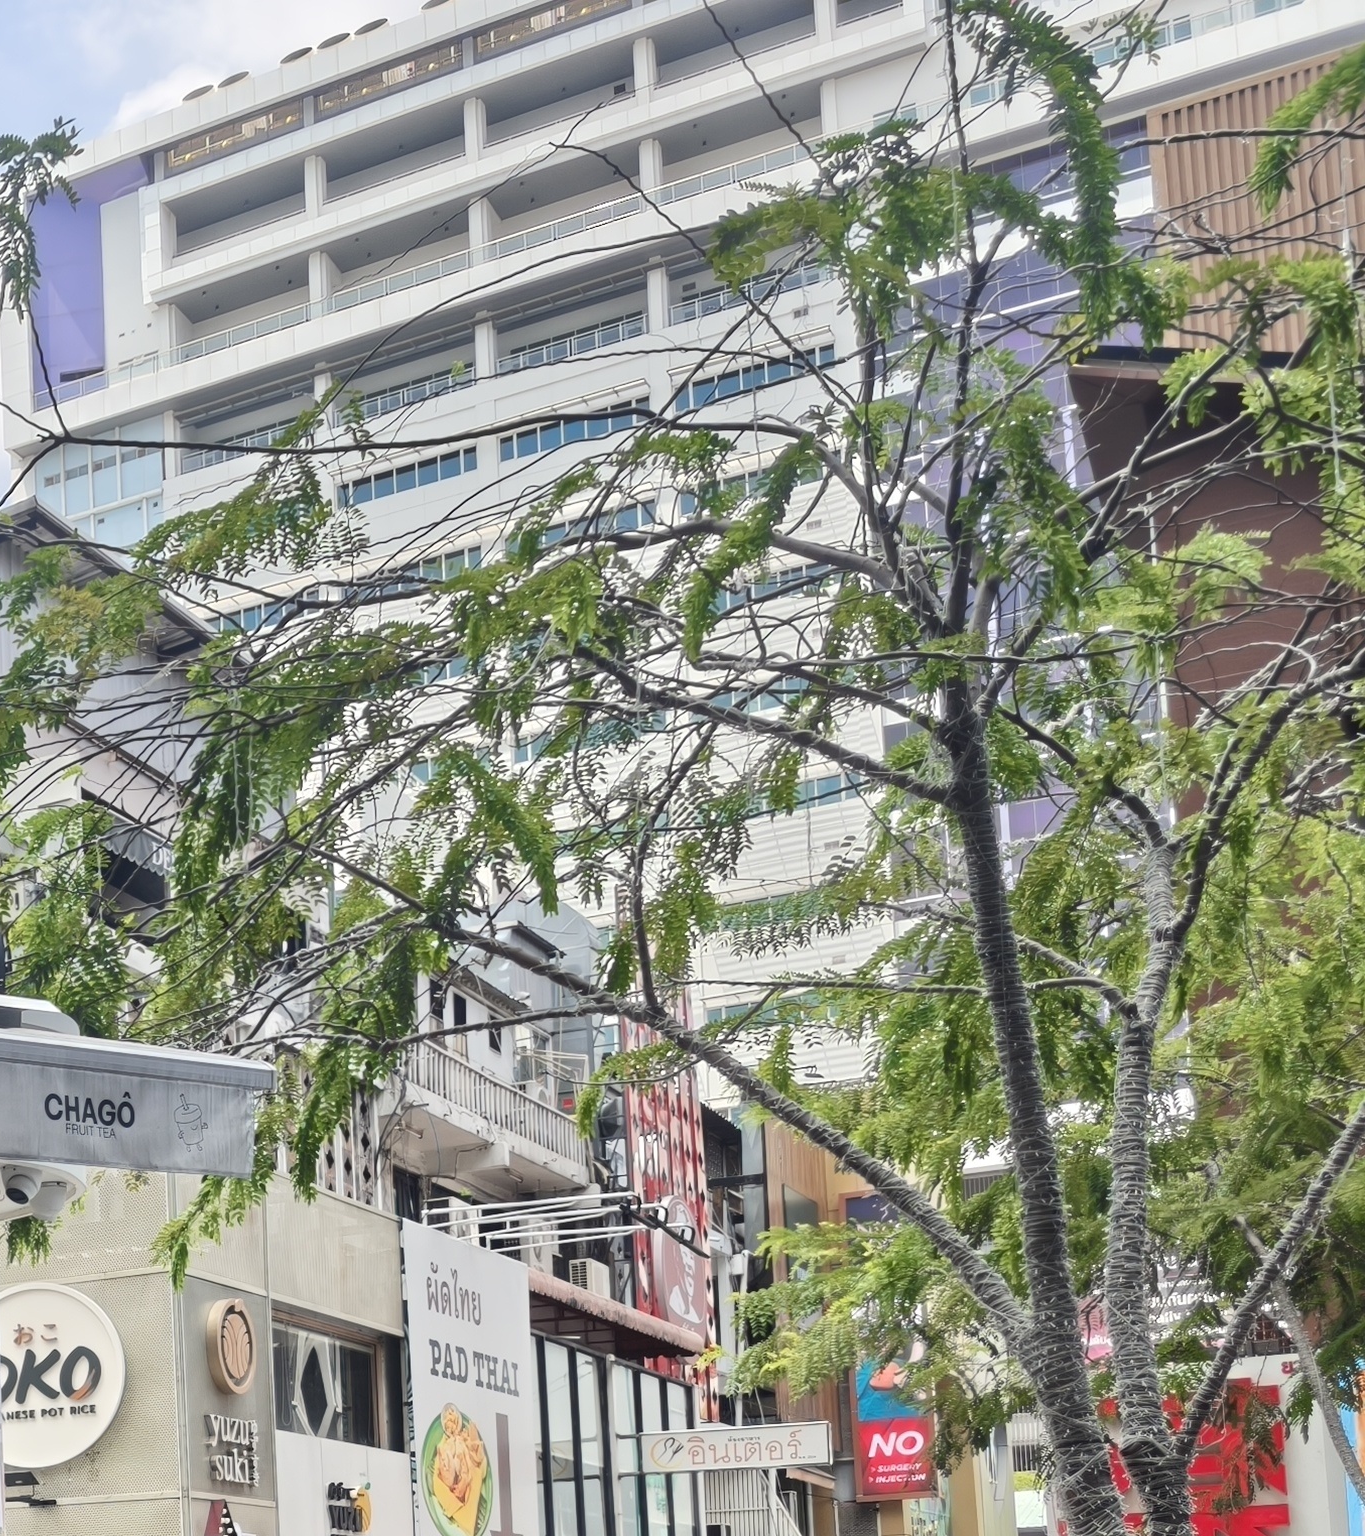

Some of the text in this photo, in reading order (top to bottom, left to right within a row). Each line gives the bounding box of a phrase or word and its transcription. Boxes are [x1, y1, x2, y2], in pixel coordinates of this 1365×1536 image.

[44, 1091, 136, 1129] CHAGÔ
[65, 1122, 118, 1140] FRUIT TEA
[426, 1261, 482, 1326] ผัดไทย
[13, 1323, 58, 1346] おこ
[429, 1338, 520, 1397] PAD THAI
[41, 1407, 64, 1418] POT
[70, 1404, 97, 1415] RICE
[207, 1413, 251, 1447] yuzu
[687, 1429, 802, 1465] อินเตอร์
[868, 1430, 924, 1458] NO
[213, 1448, 251, 1484] suki
